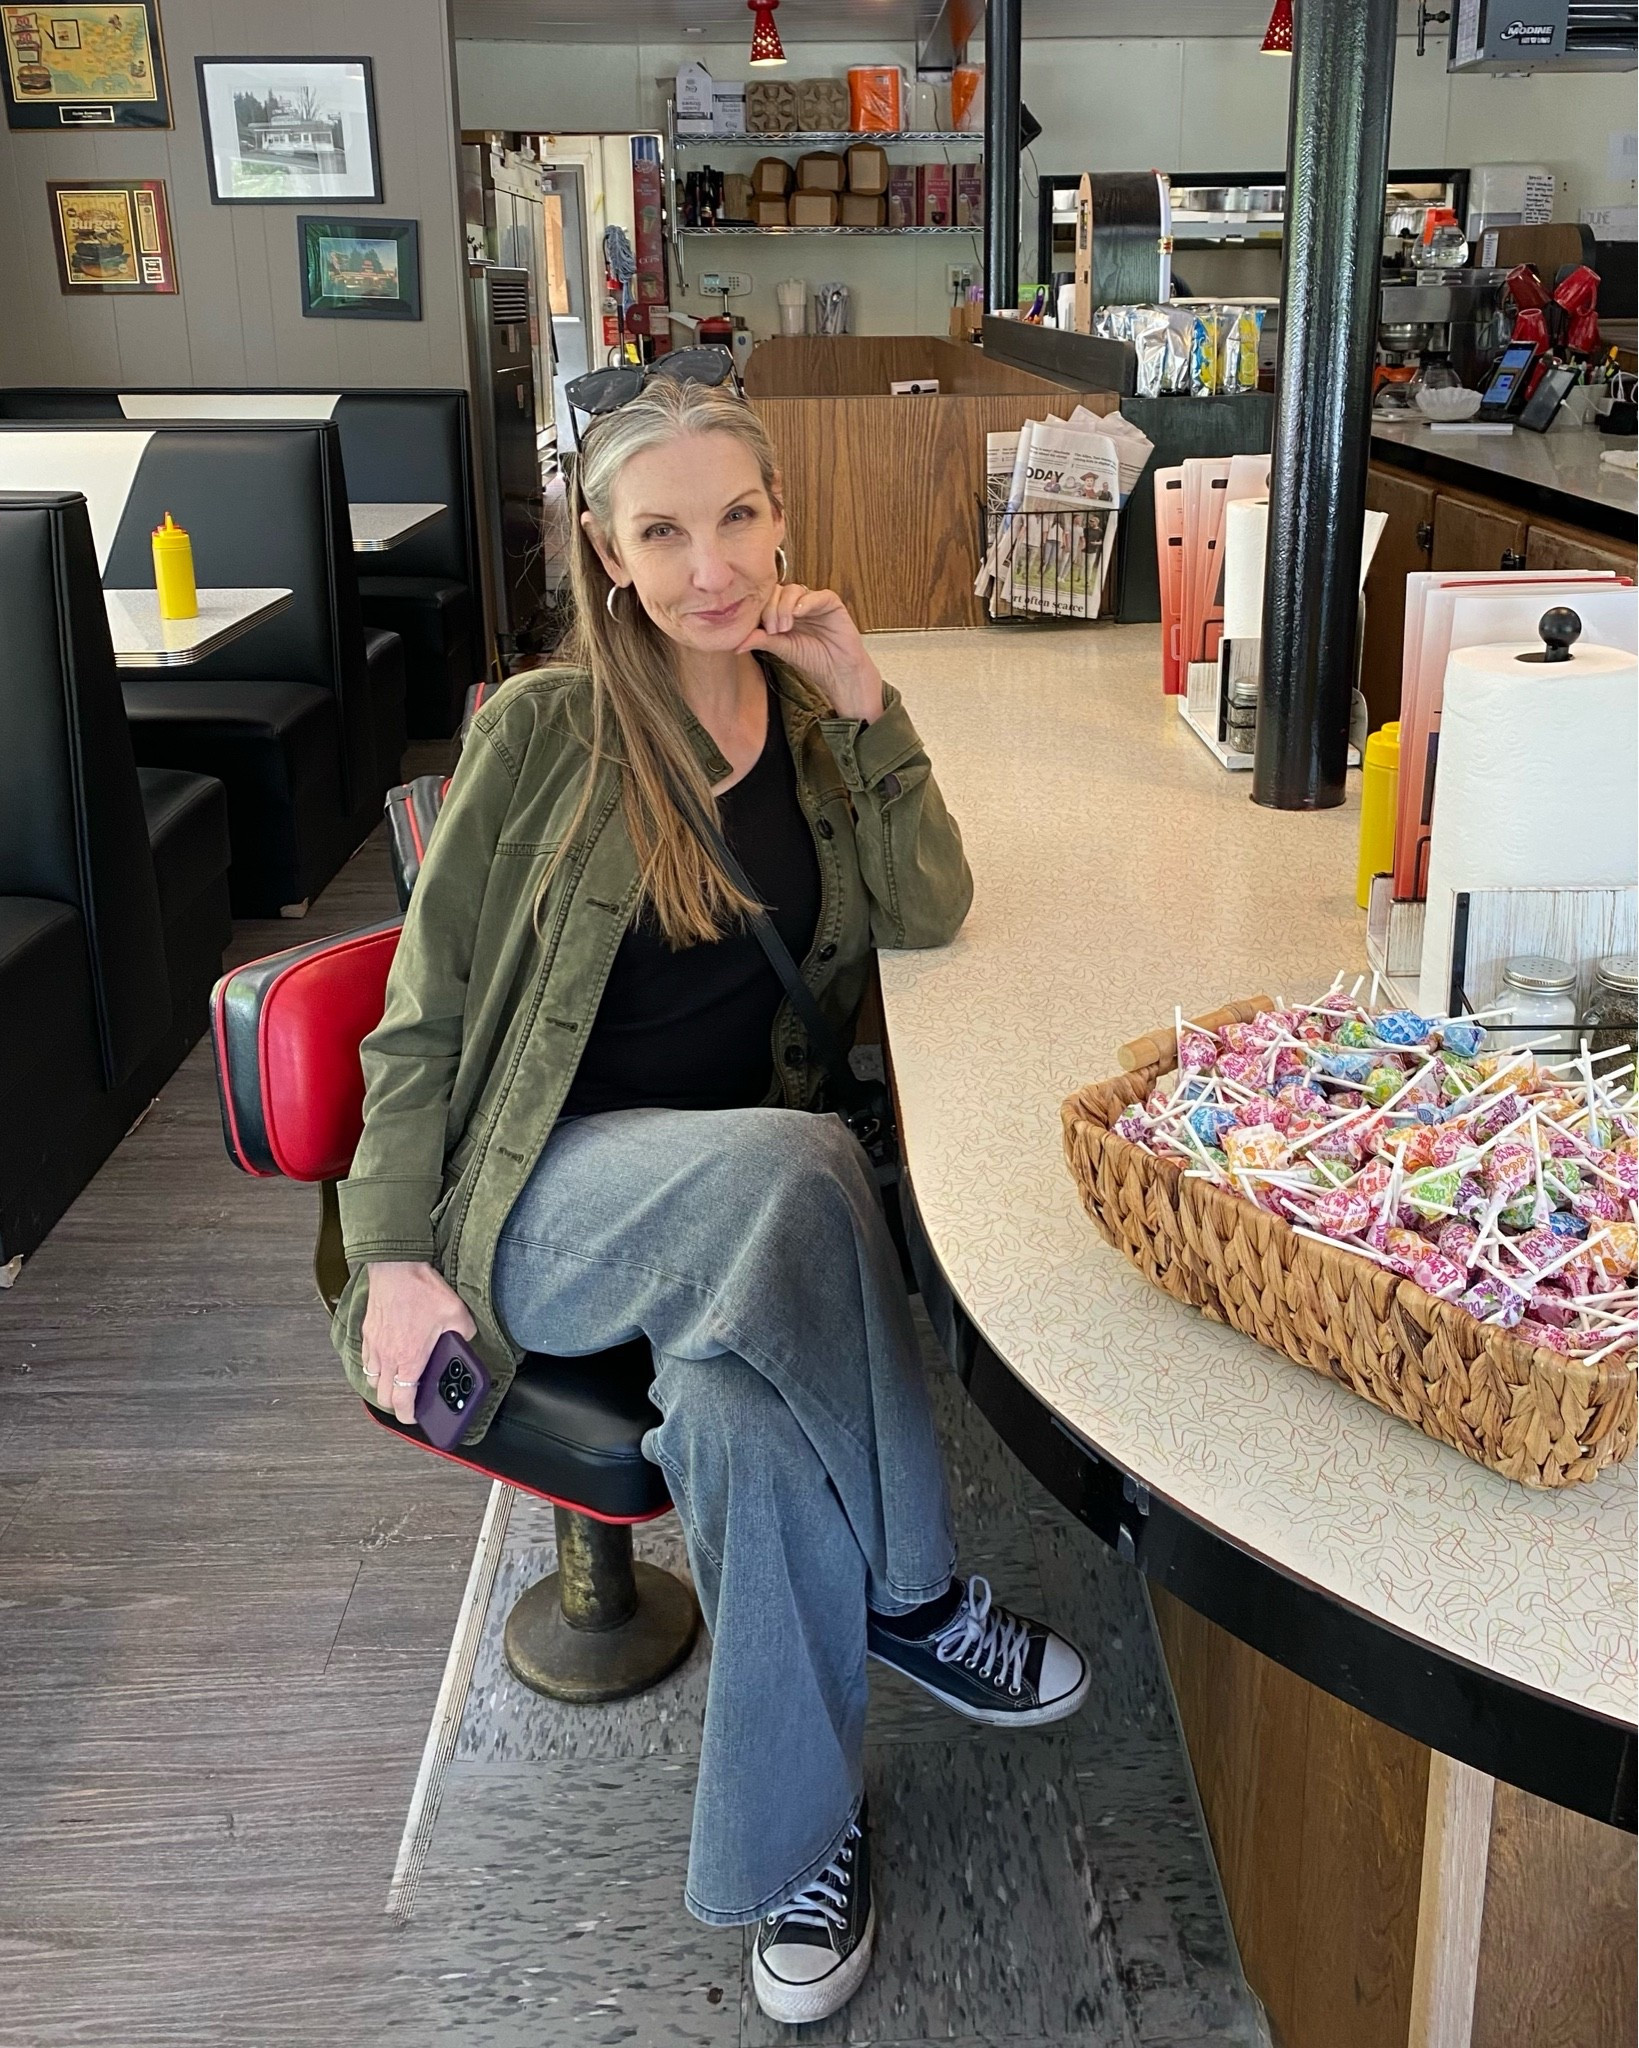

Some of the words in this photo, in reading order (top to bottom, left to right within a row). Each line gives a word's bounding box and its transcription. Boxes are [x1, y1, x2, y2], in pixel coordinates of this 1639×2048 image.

[1508, 26, 1553, 35] MODINE
[68, 218, 125, 231] Burgers
[1026, 466, 1064, 484] ODAY
[1024, 594, 1050, 607] often
[1052, 601, 1084, 613] scarce
